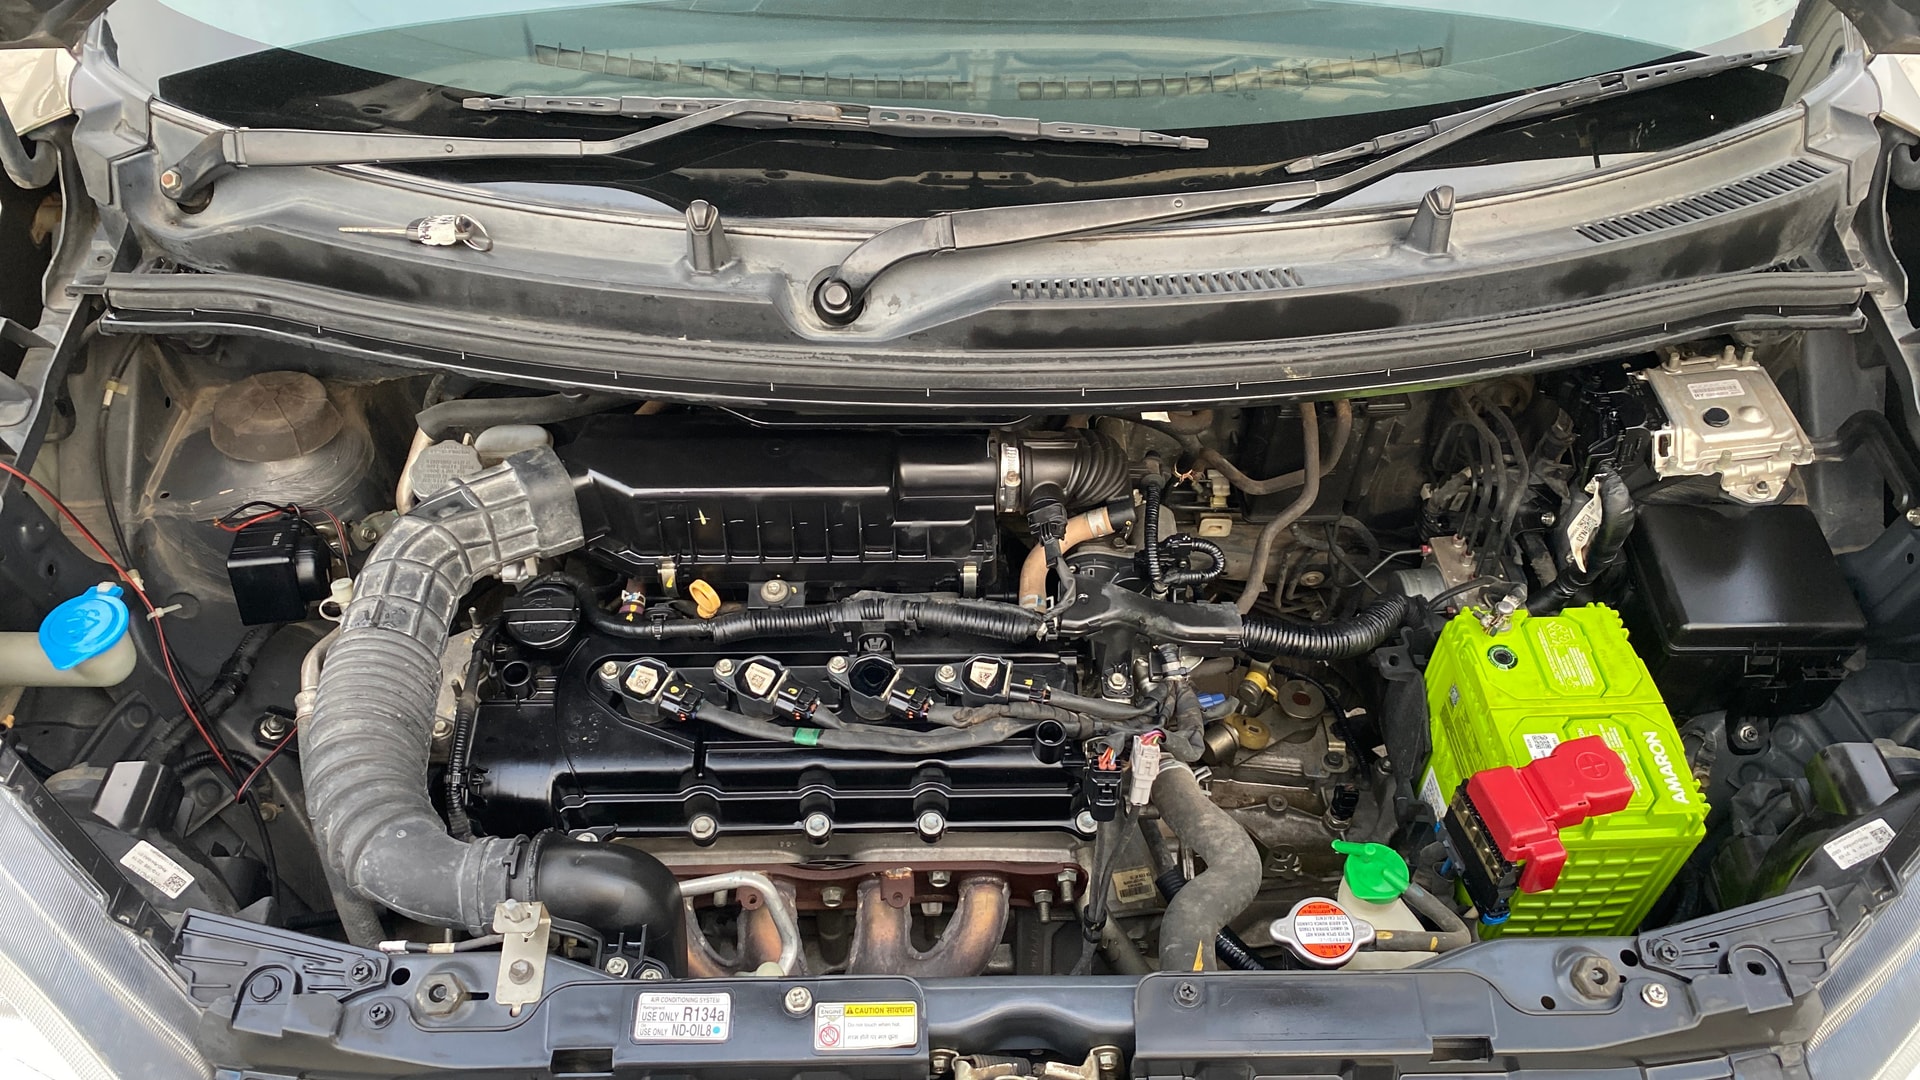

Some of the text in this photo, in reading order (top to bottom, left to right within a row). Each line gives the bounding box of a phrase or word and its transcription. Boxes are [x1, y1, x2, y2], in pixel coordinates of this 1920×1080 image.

[1642, 731, 1690, 804] AMARON
[641, 1006, 725, 1022] USE ONLY R134a
[885, 1006, 914, 1014] सावधान
[639, 1023, 712, 1037] USE ONLY ND-OIL8
